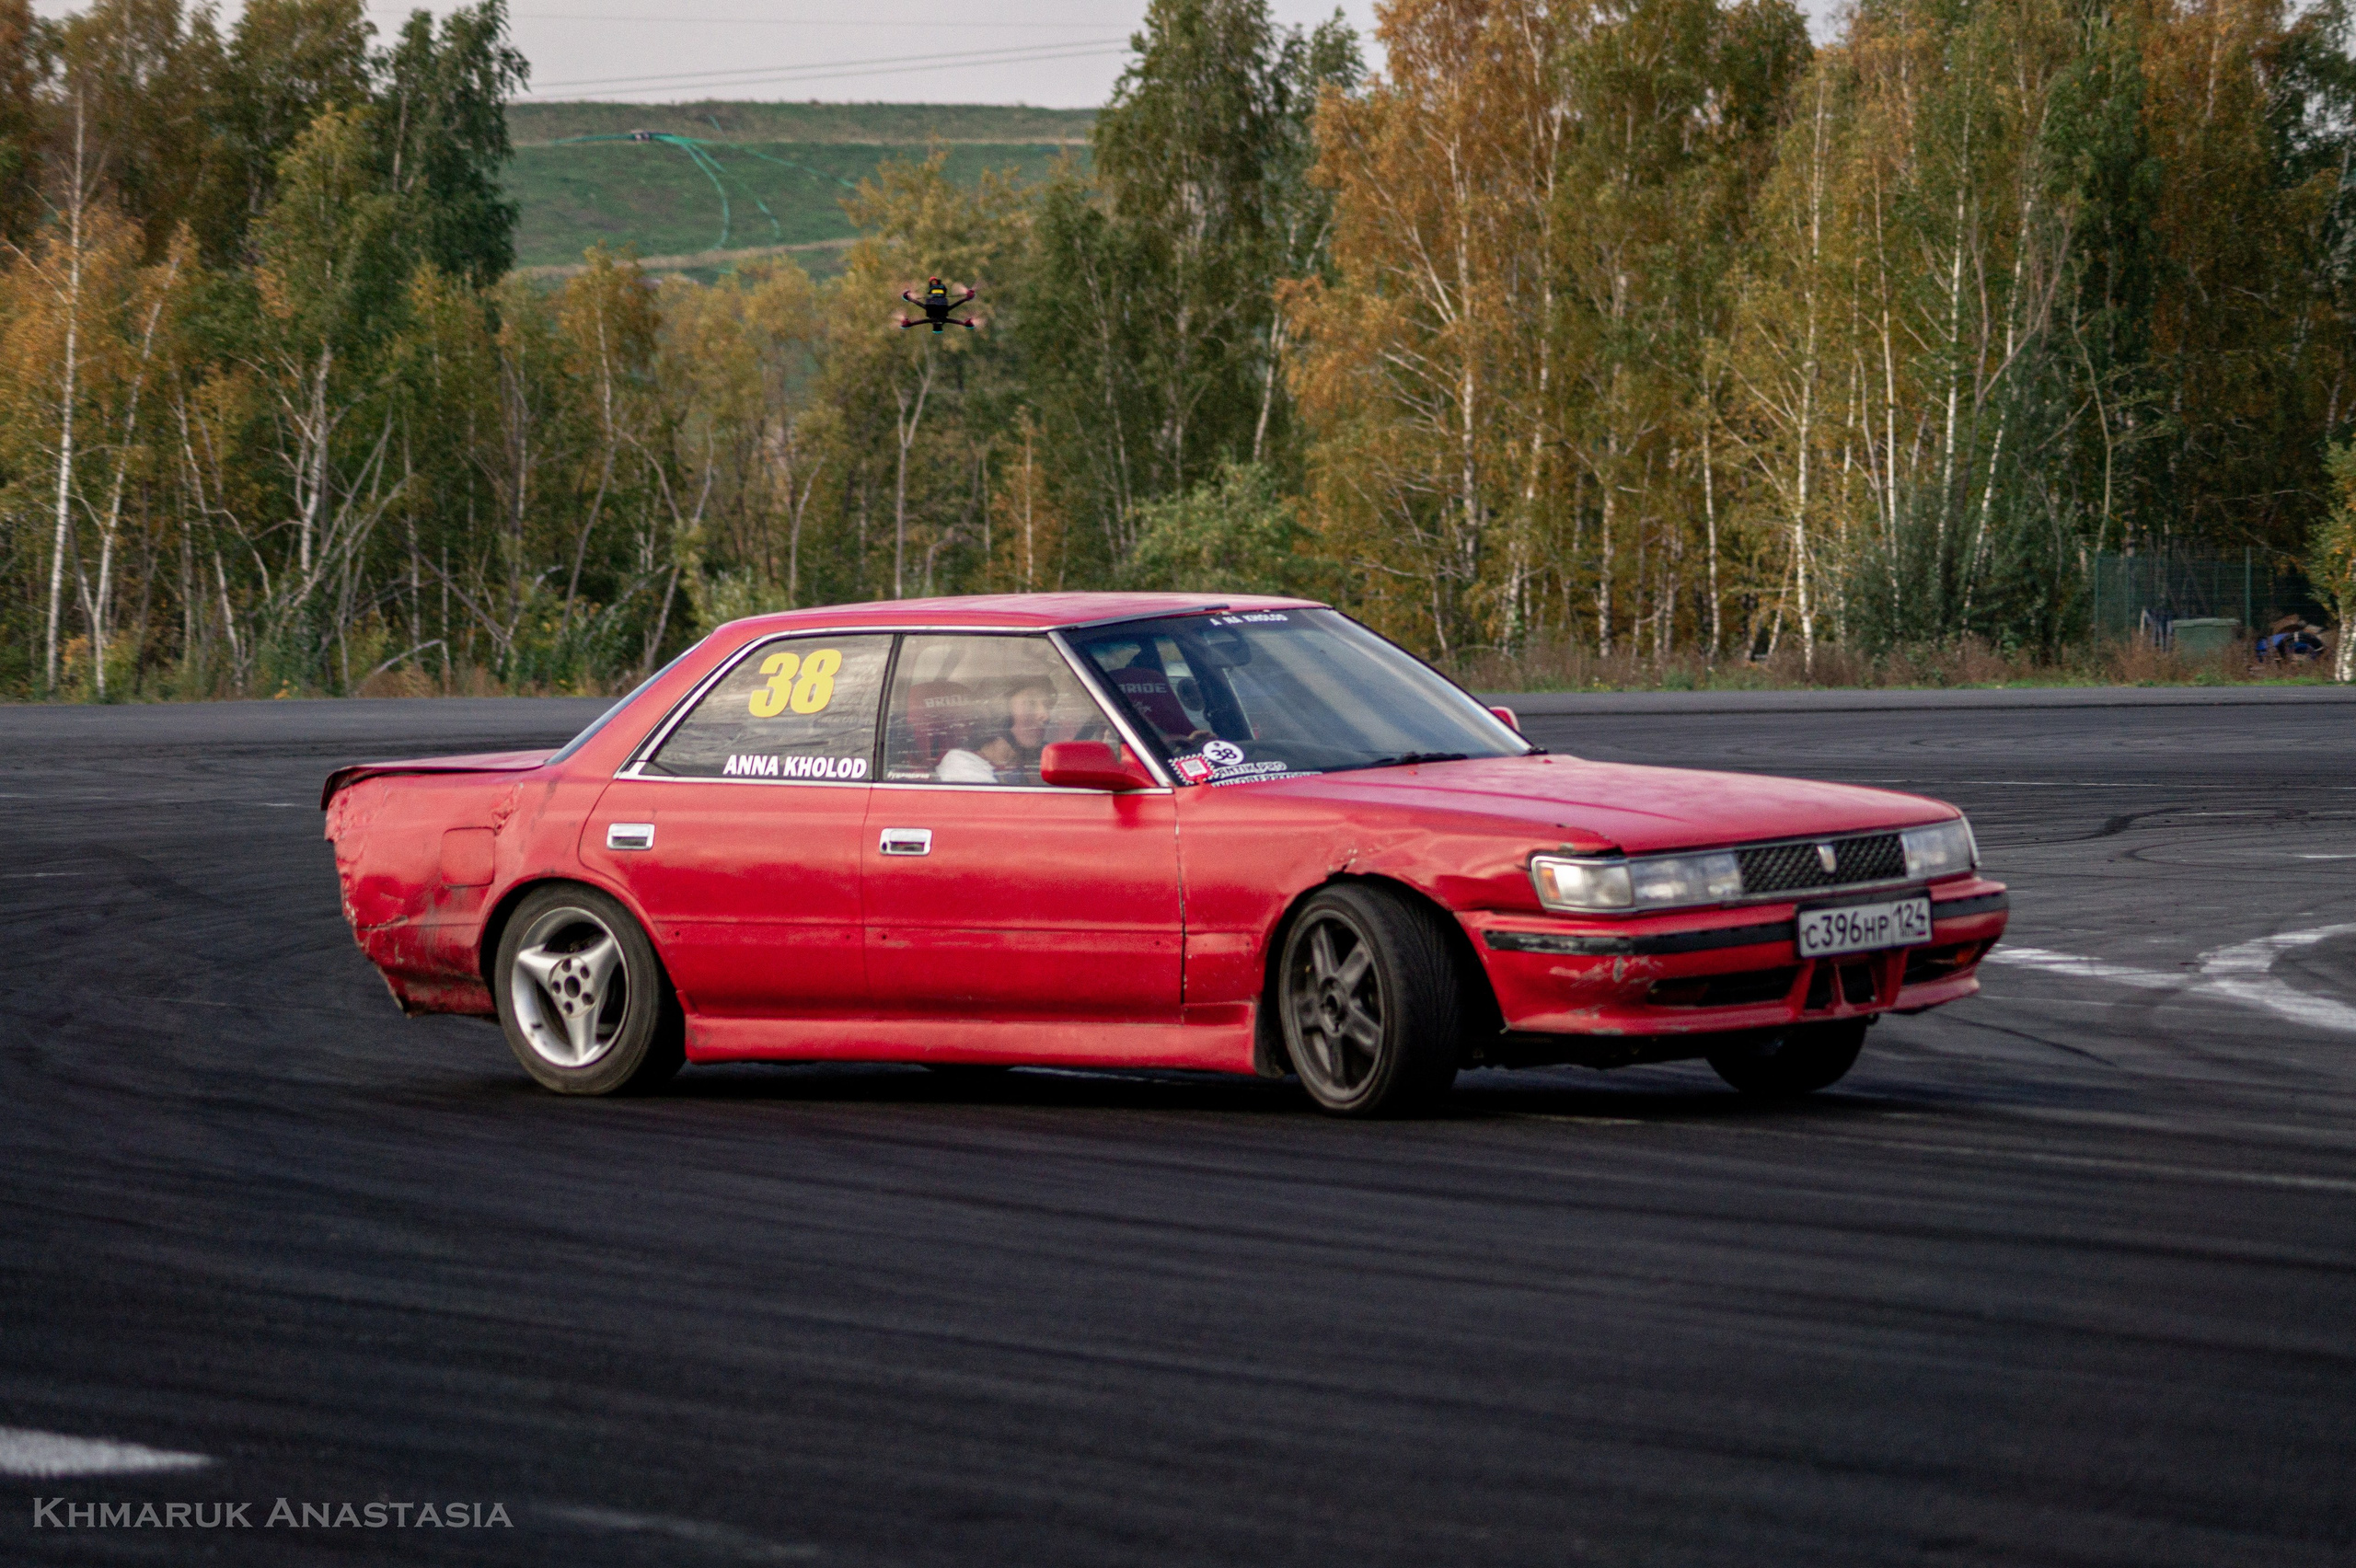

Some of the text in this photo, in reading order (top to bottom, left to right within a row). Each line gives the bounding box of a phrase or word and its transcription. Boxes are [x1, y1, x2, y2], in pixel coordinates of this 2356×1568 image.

[748, 648, 843, 718] 38
[1210, 747, 1238, 761] 38
[722, 755, 780, 777] ANNA
[783, 755, 868, 779] KHOLOD
